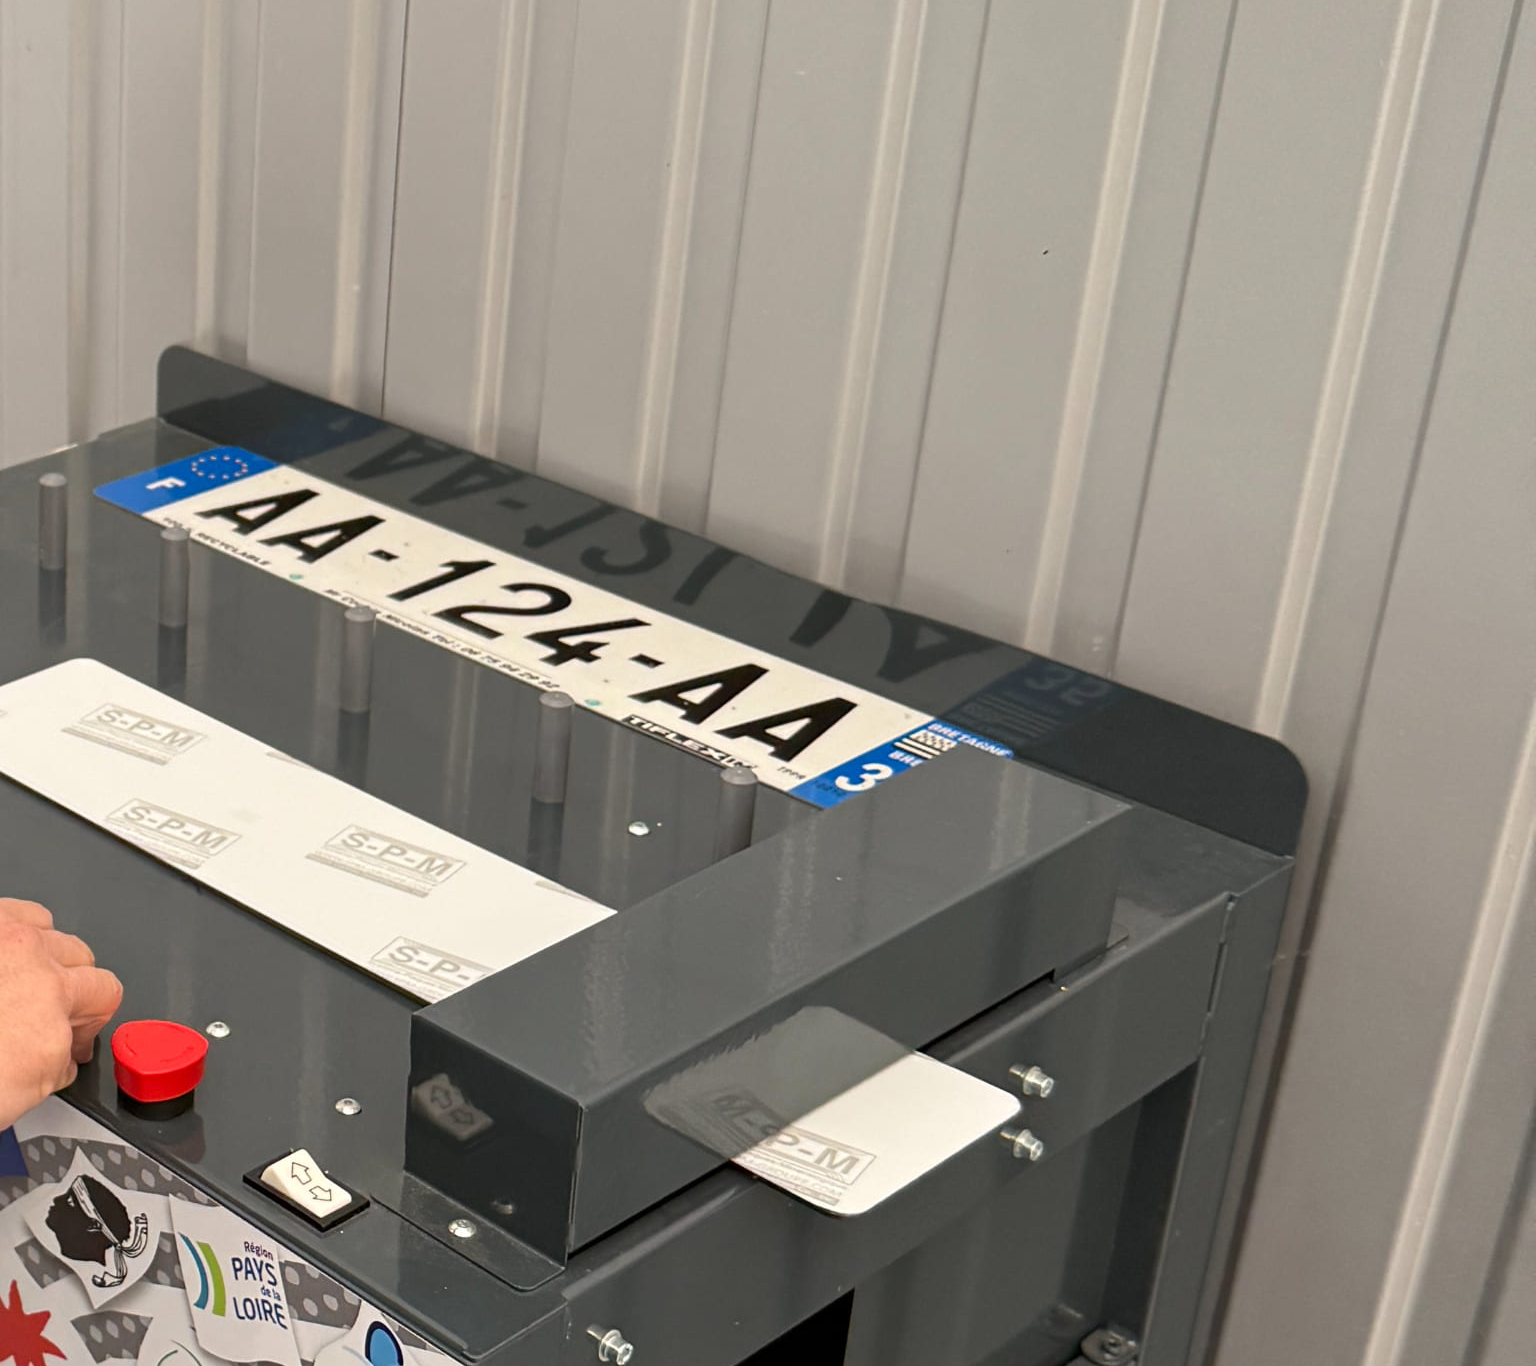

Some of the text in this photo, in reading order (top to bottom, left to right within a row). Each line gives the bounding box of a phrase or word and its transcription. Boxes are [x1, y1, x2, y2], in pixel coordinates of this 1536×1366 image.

[145, 477, 187, 490] F
[194, 488, 858, 764] AA-124-AA
[96, 709, 195, 749] S-P-M
[629, 715, 727, 761] TIFLEX
[123, 806, 228, 850] S-P-M
[340, 832, 453, 877] S-P-M
[244, 1241, 274, 1261] Région
[231, 1257, 277, 1286] PAYS
[232, 1296, 288, 1330] LOIRE
